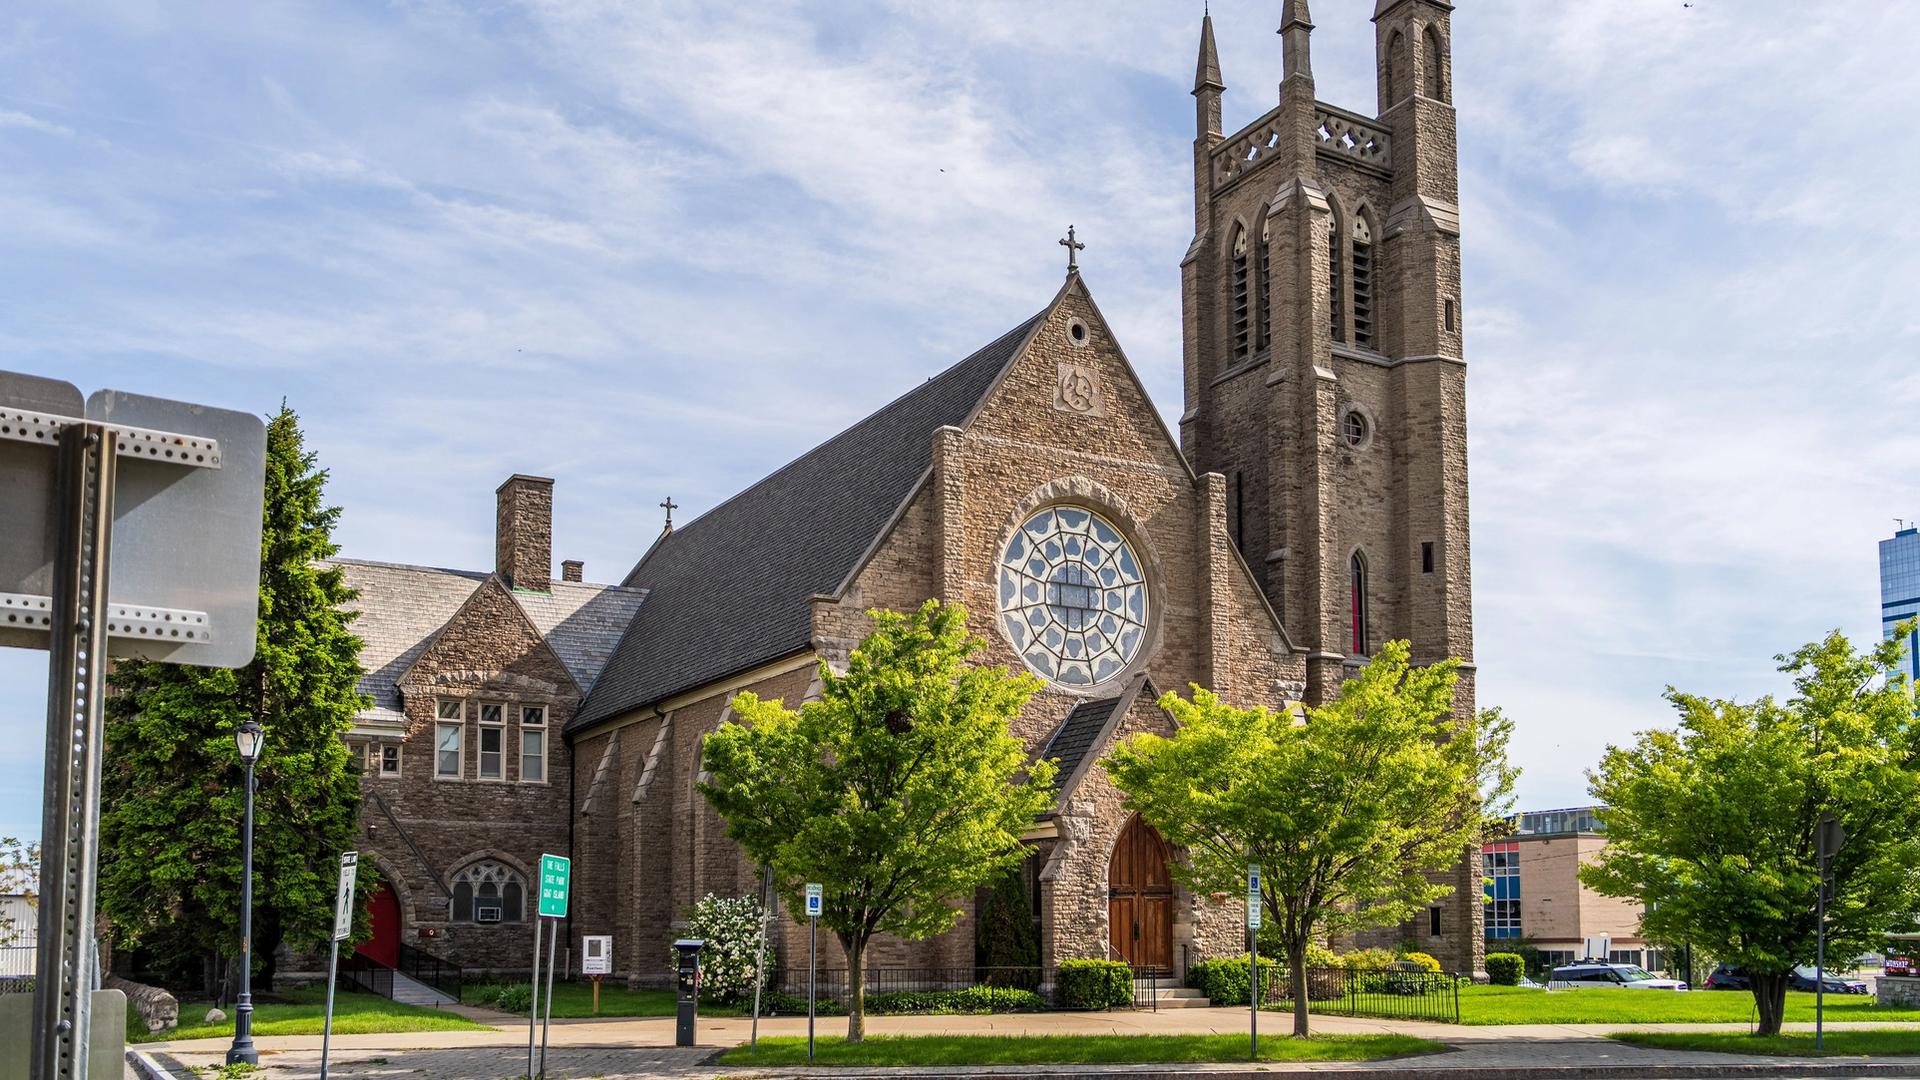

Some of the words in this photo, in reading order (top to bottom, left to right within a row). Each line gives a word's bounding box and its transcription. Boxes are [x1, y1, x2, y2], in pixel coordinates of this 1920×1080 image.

[555, 861, 565, 872] FALLS
[545, 874, 555, 885] STATE
[556, 876, 565, 886] PARK
[553, 890, 565, 900] ISLAND
[1885, 959, 1909, 968] WORSHIP
